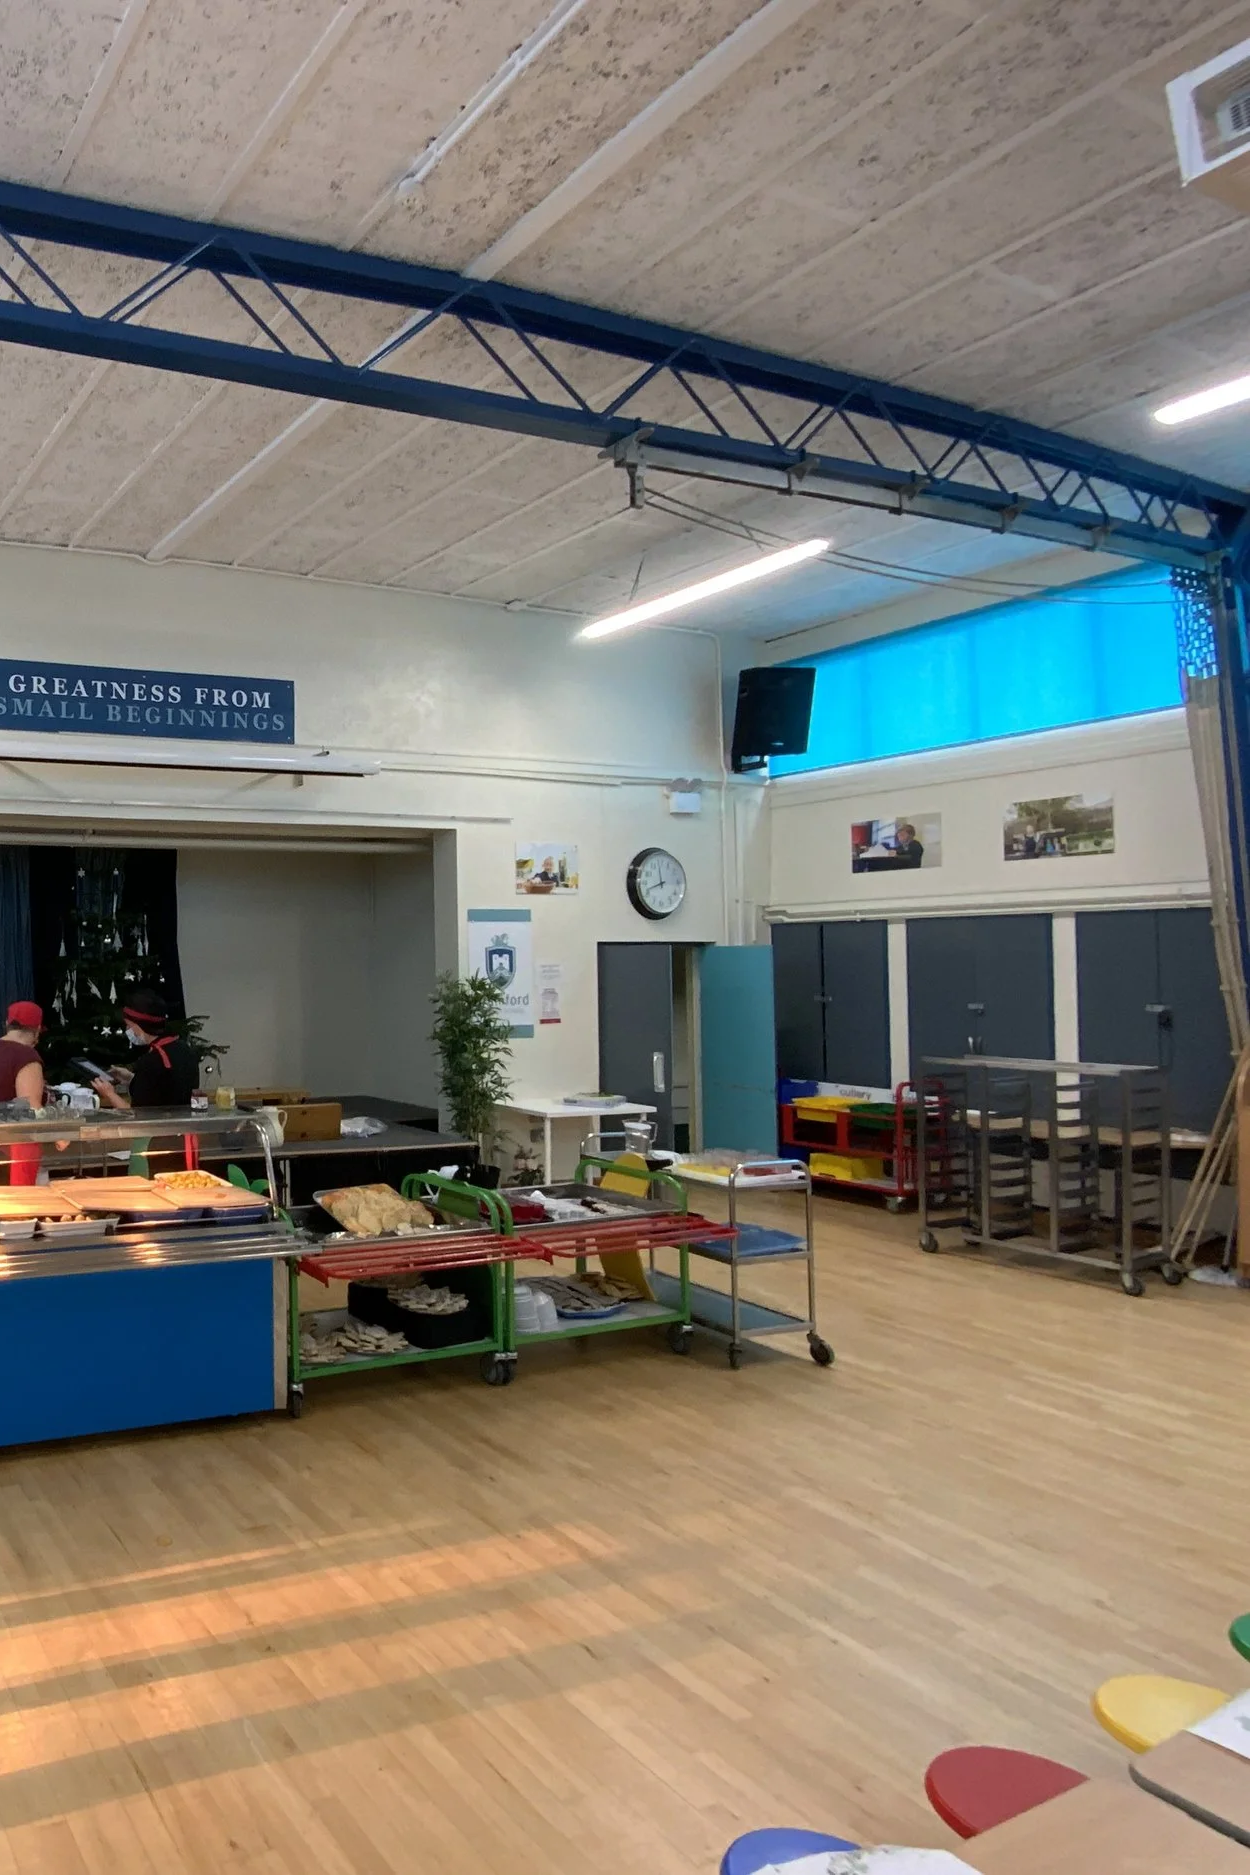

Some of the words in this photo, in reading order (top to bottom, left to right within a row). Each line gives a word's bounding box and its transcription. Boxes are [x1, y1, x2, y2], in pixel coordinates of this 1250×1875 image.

[8, 674, 182, 703] GREATNESS
[194, 687, 271, 709] FROM
[106, 704, 285, 731] BEGINNINGS
